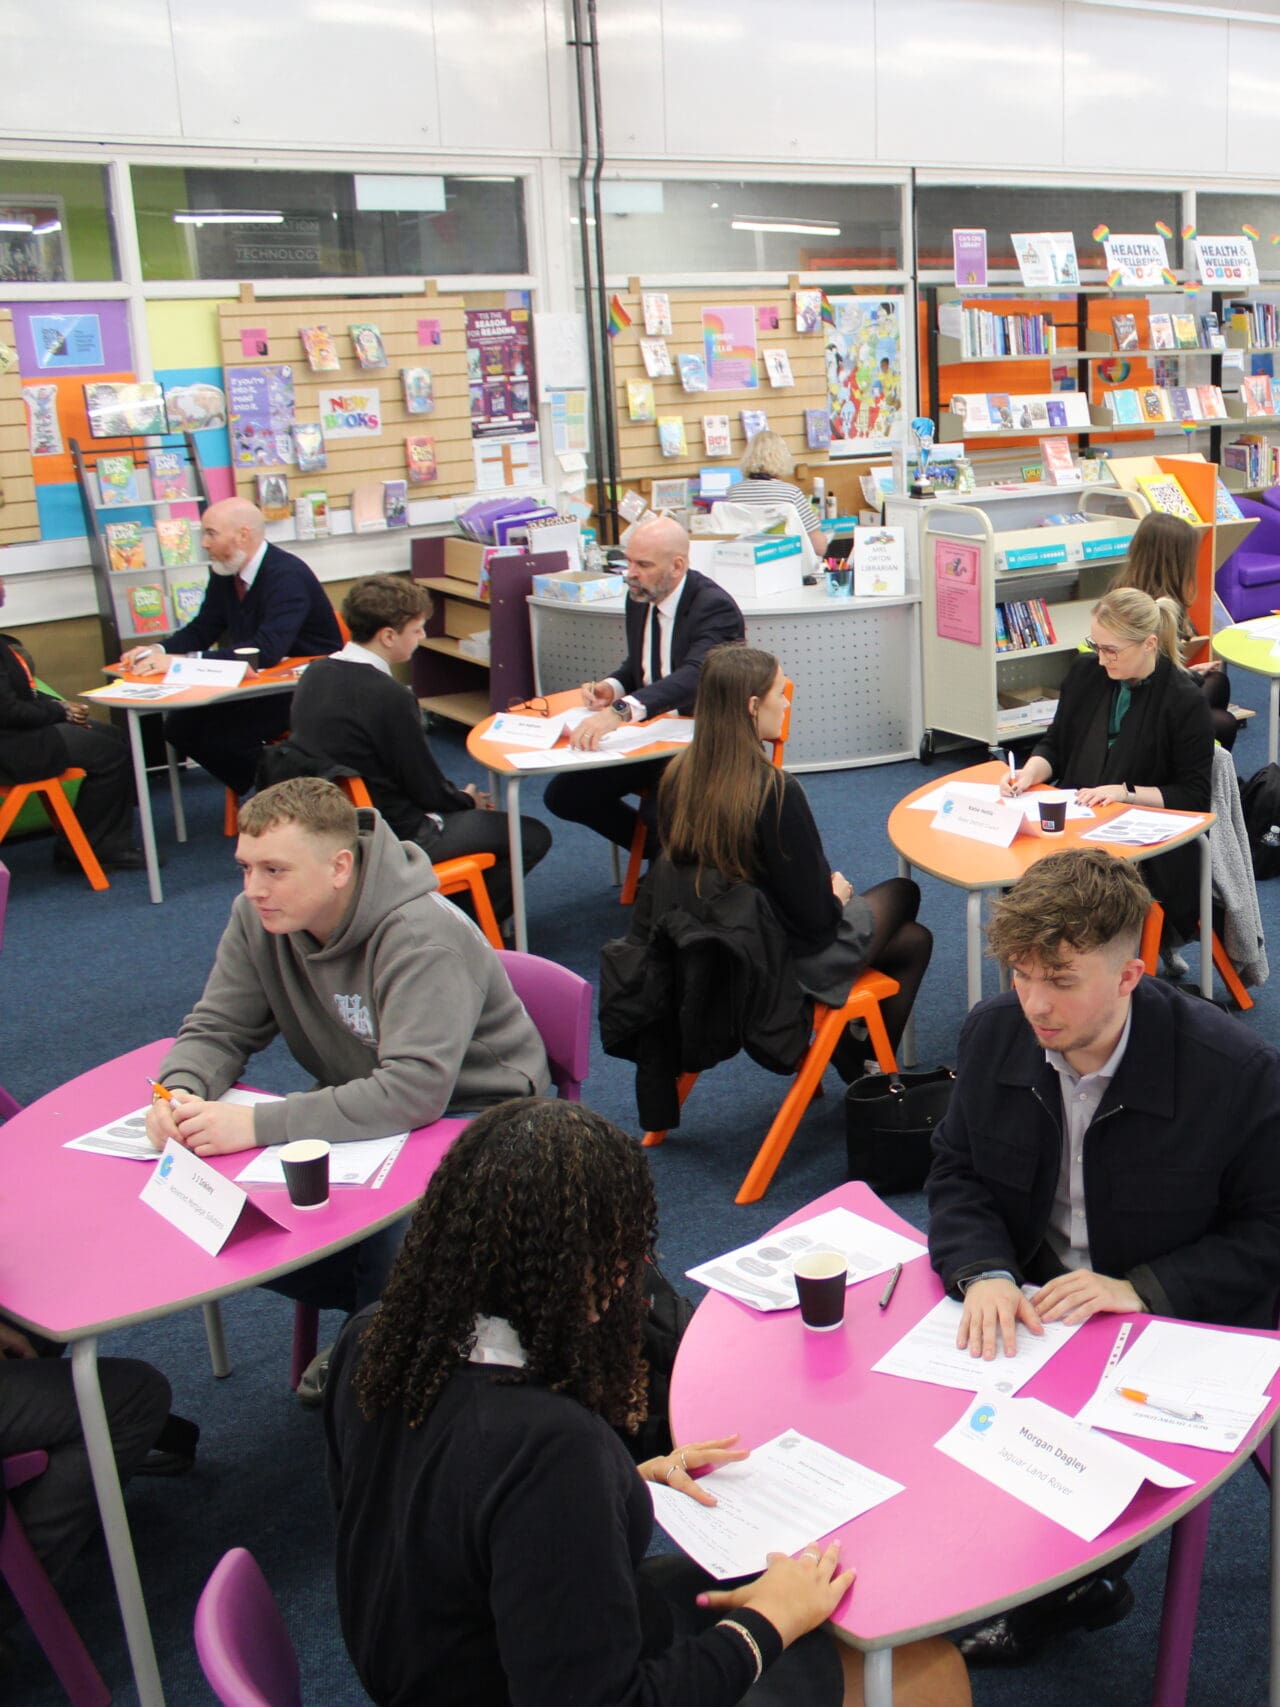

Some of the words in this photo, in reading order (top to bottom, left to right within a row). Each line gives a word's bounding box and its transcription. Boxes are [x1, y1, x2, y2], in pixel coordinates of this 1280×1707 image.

[237, 247, 320, 260] TECHNOLOGY
[1110, 244, 1150, 256] HEALTH
[1151, 246, 1160, 257] &
[1200, 245, 1239, 257] HEALTH
[1239, 245, 1248, 257] &
[1204, 257, 1250, 267] WELLBEING
[475, 319, 507, 329] SEASON
[468, 329, 480, 337] FOR
[481, 327, 516, 337] READING
[238, 377, 265, 386] you're
[232, 395, 254, 403] read
[329, 395, 370, 412] NEW
[324, 413, 380, 429] BOOKS
[709, 435, 728, 446] BOY
[1019, 1427, 1052, 1452] Morgan
[1054, 1448, 1087, 1474] Dagley
[999, 1447, 1026, 1467] Jaguar
[1026, 1464, 1047, 1481] Land
[1048, 1477, 1072, 1496] Rover
